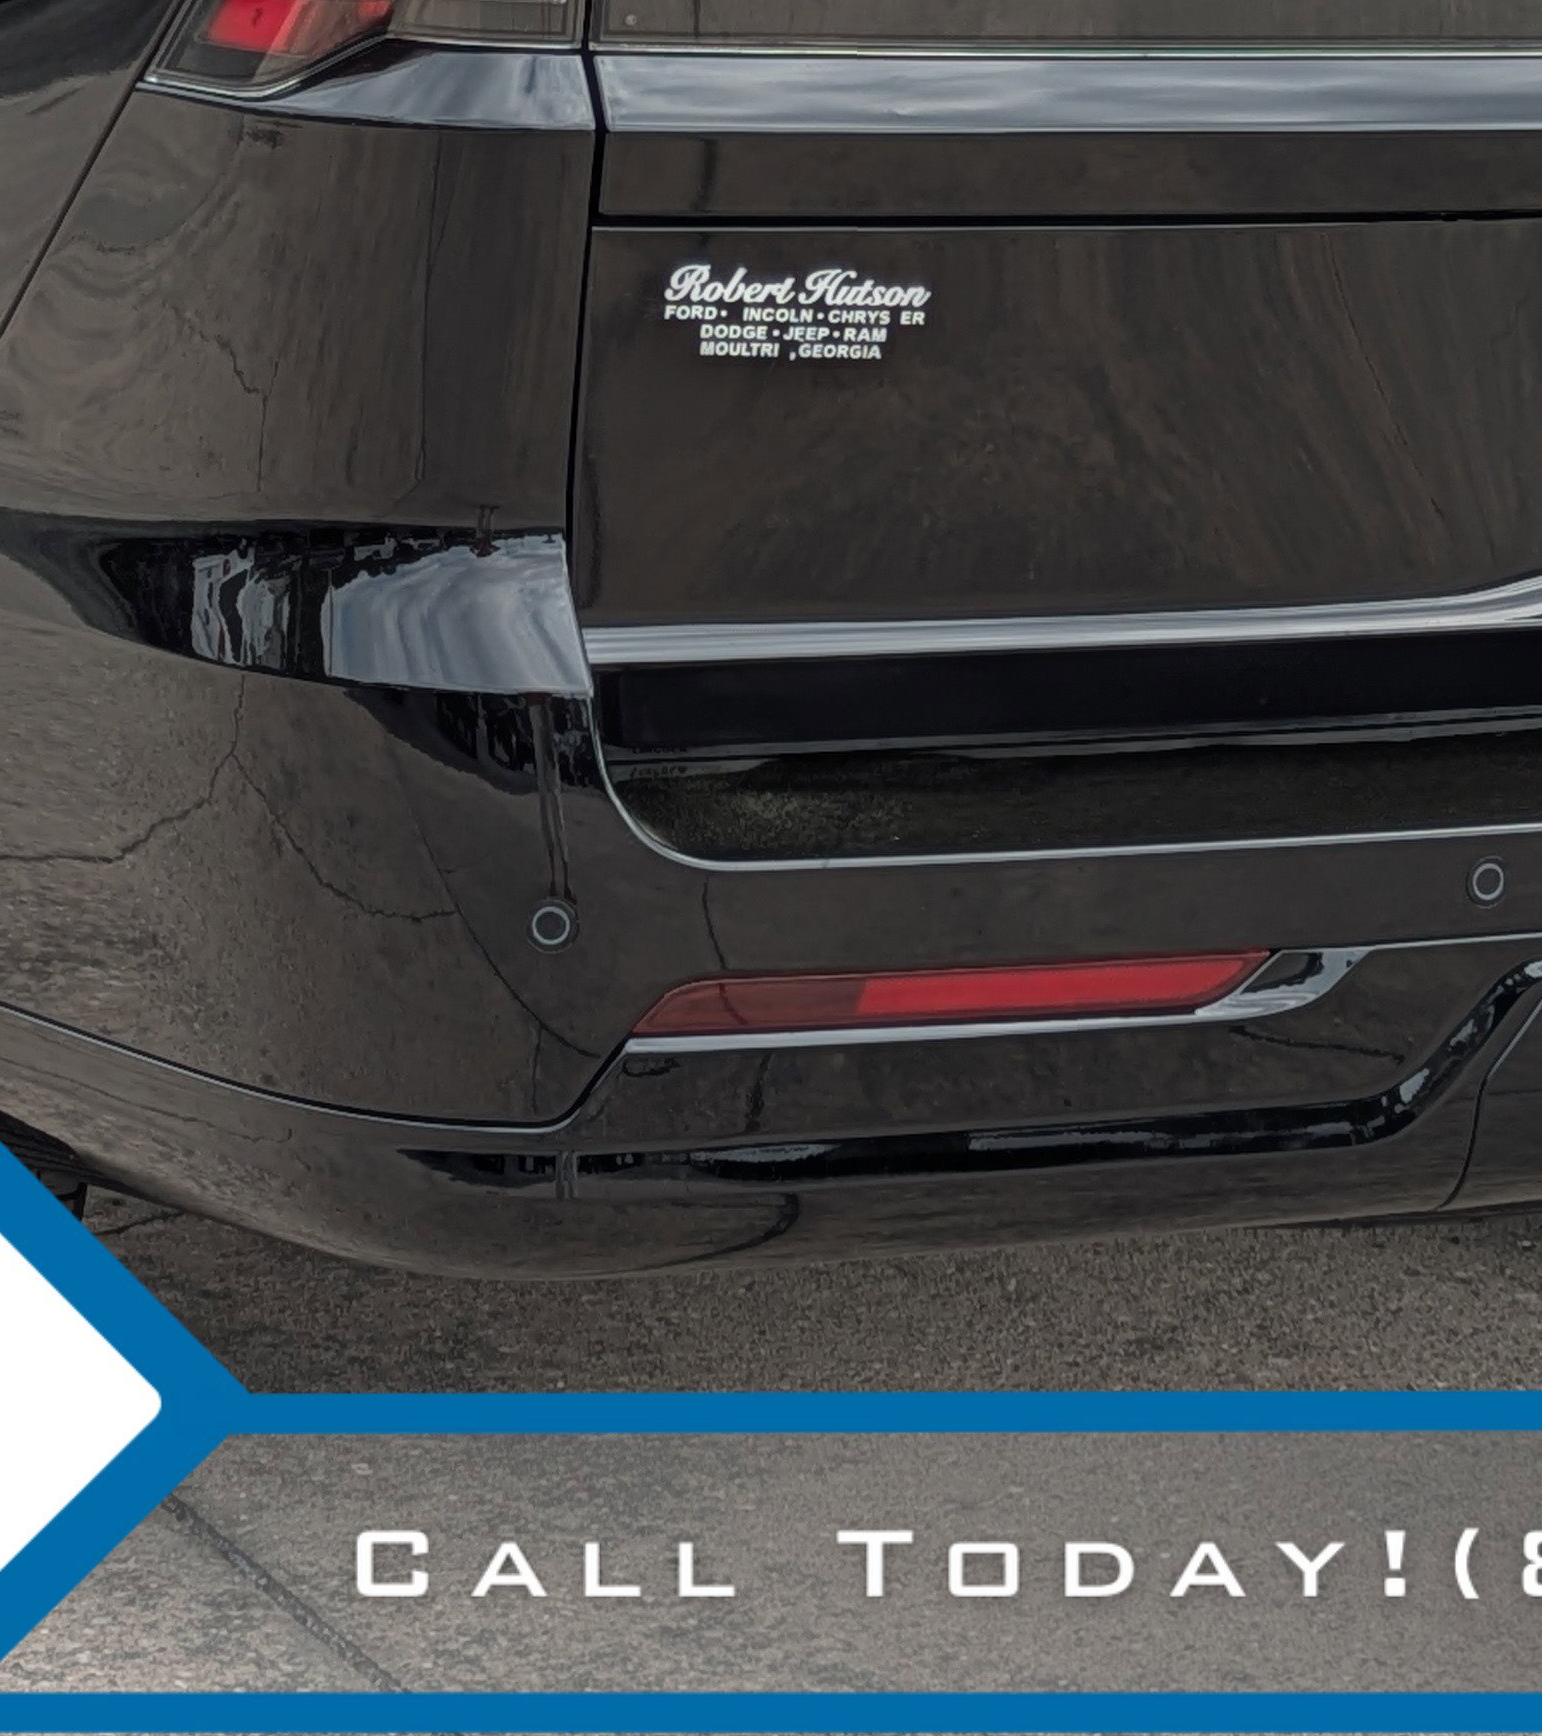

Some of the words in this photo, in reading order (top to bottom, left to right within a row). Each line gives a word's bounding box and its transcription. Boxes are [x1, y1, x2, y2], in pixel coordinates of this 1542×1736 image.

[664, 264, 796, 304] Robert
[798, 268, 932, 308] Hutson
[664, 305, 718, 320] FORD
[742, 307, 814, 324] INCOLN
[828, 310, 926, 326] CHRYSER
[700, 325, 769, 340] DODGE
[783, 326, 830, 342] JEEP
[843, 327, 888, 343] RAM
[700, 341, 796, 361] MOULTRI,
[798, 344, 883, 360] GEORGIA
